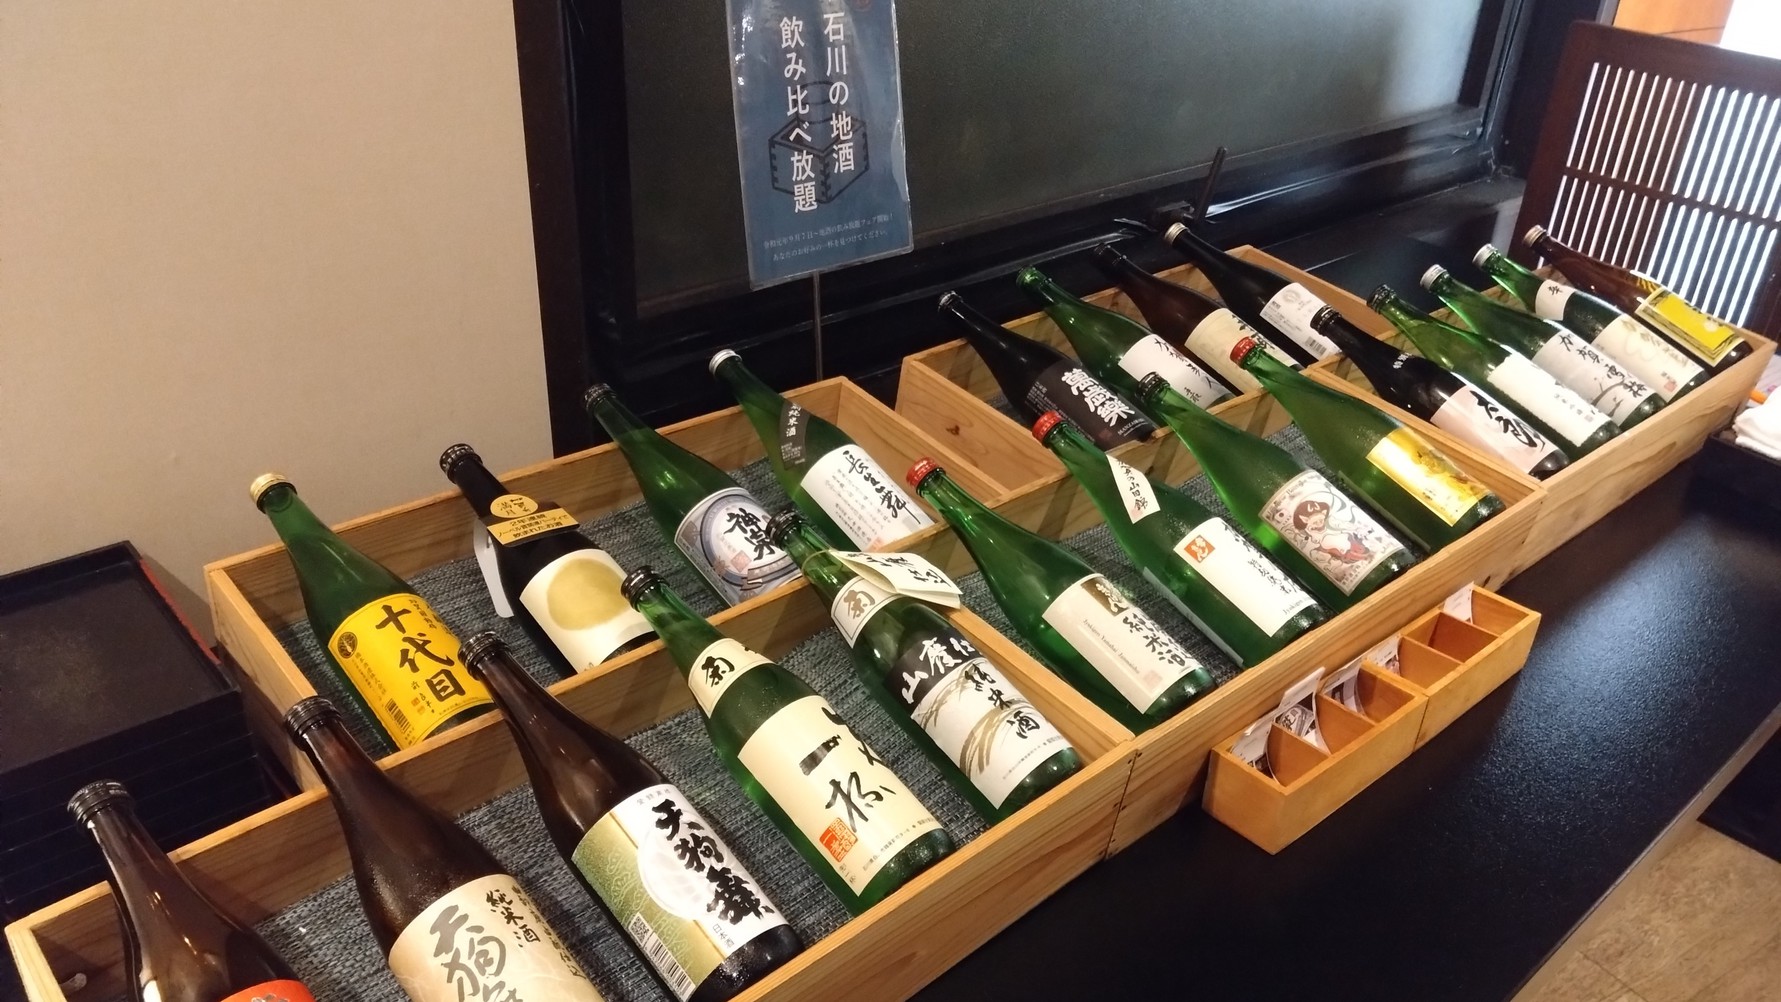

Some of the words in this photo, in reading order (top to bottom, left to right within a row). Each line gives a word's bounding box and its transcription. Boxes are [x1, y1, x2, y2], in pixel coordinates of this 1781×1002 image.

[779, 16, 818, 214] 飲み比べ放題
[823, 11, 856, 174] 石川の地酒
[375, 604, 466, 703] 十代目
[1122, 612, 1186, 667] 純米酒
[964, 662, 1041, 740] 純米酒
[651, 798, 776, 926] 天狗舞
[485, 887, 541, 947] 純米酒
[712, 923, 735, 949] 日本酒
